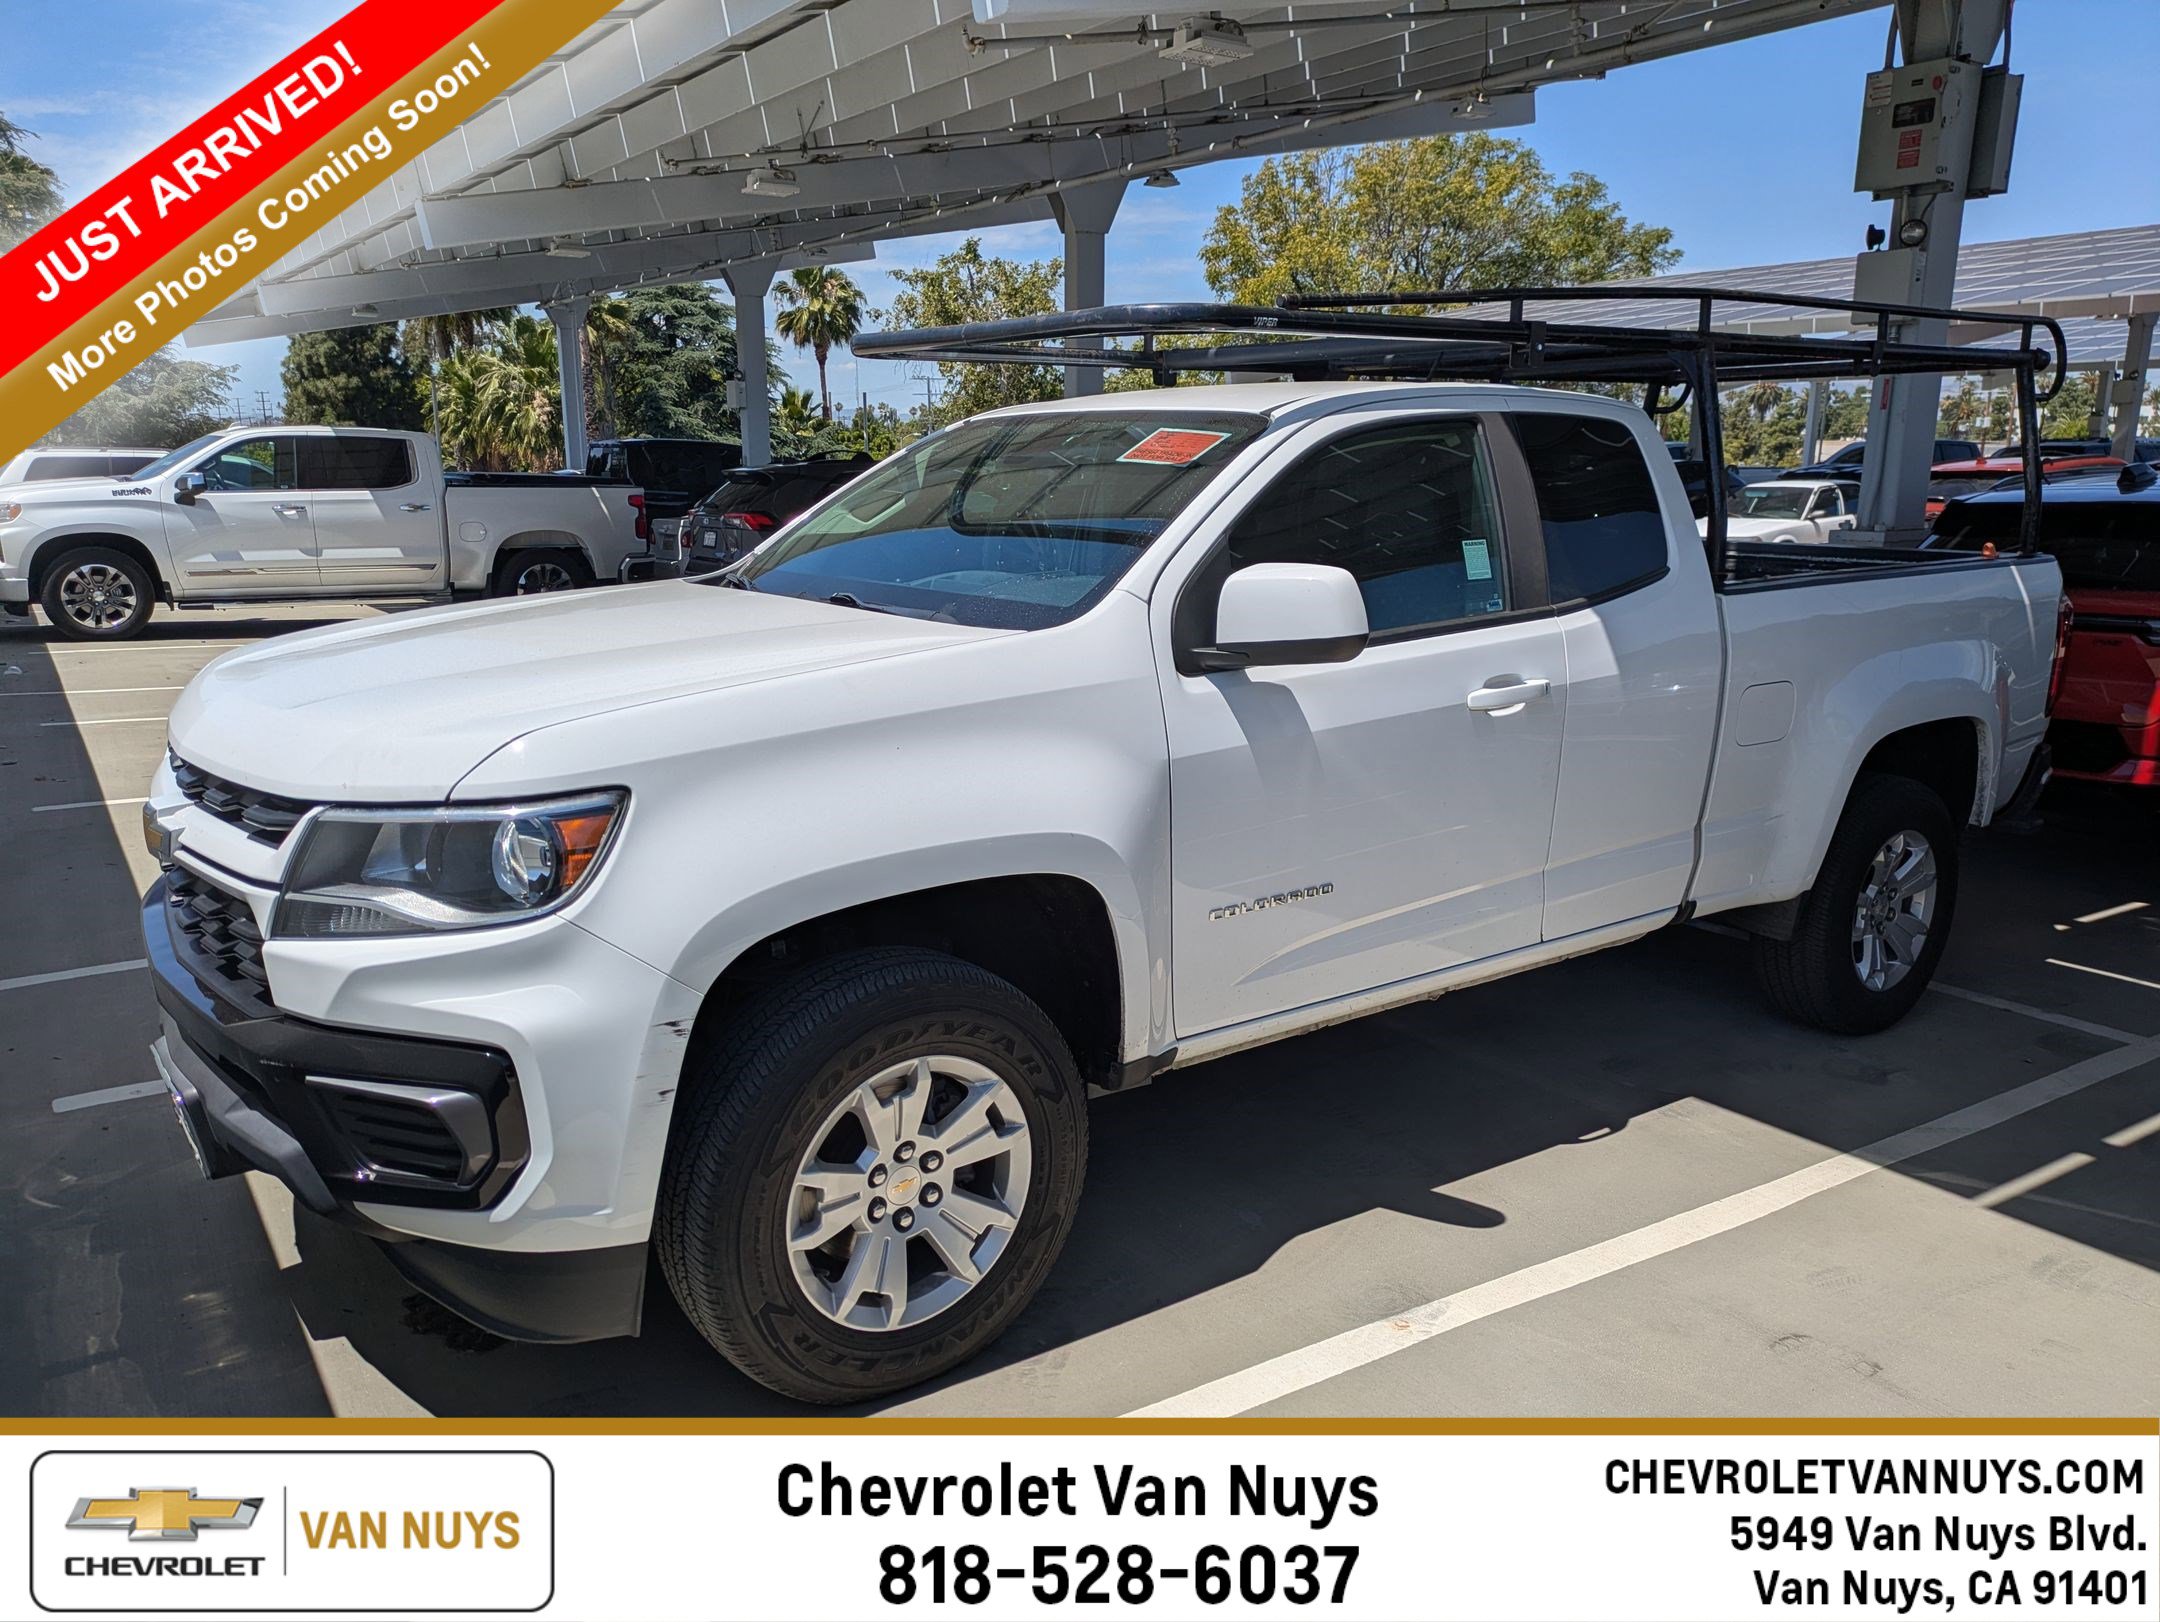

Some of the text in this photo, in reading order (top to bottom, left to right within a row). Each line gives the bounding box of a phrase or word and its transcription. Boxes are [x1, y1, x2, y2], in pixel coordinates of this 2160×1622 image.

[1254, 316, 1279, 326] VIPER
[1208, 882, 1334, 921] COLORADO
[791, 1019, 1045, 1135] GOODYEAR
